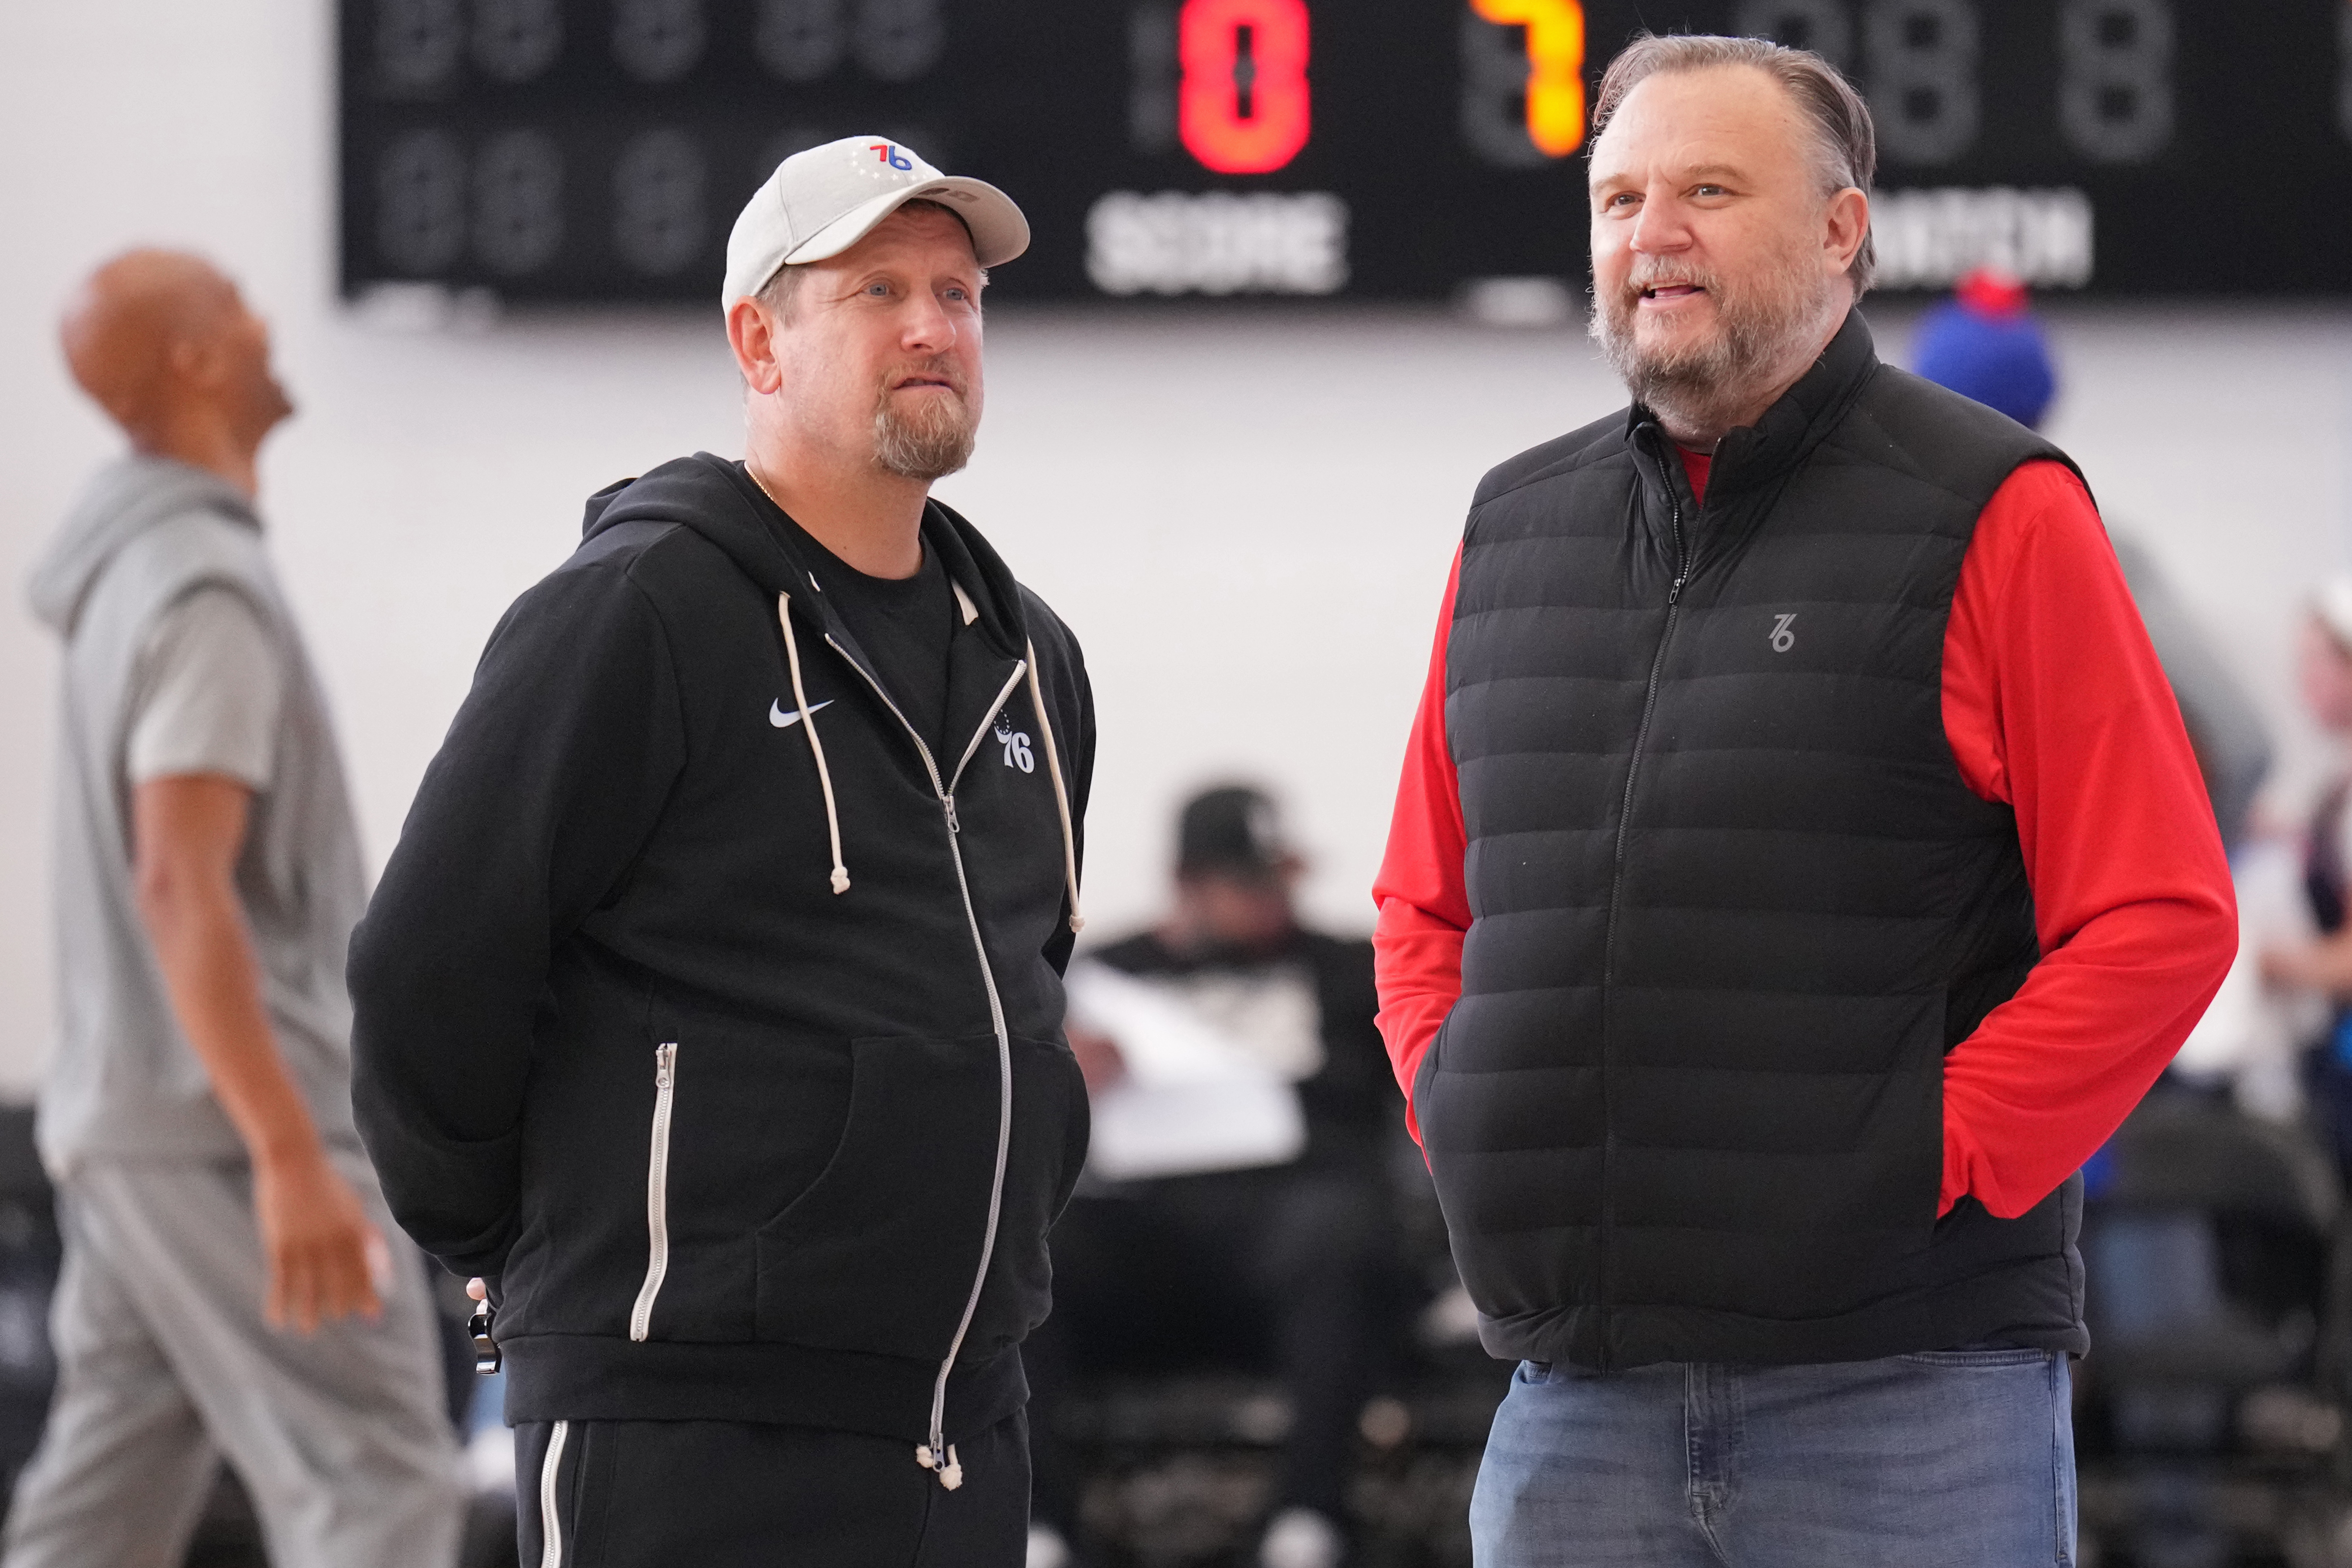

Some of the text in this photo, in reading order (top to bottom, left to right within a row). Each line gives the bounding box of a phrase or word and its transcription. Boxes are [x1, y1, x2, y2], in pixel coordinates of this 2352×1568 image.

[1179, 0, 1310, 174] 0
[1469, 0, 1584, 158] 7
[869, 144, 912, 171] 76
[1088, 191, 1349, 293] SCORE
[1872, 187, 2093, 289] ATCH
[1768, 613, 1798, 653] 76
[994, 725, 1035, 774] 76
